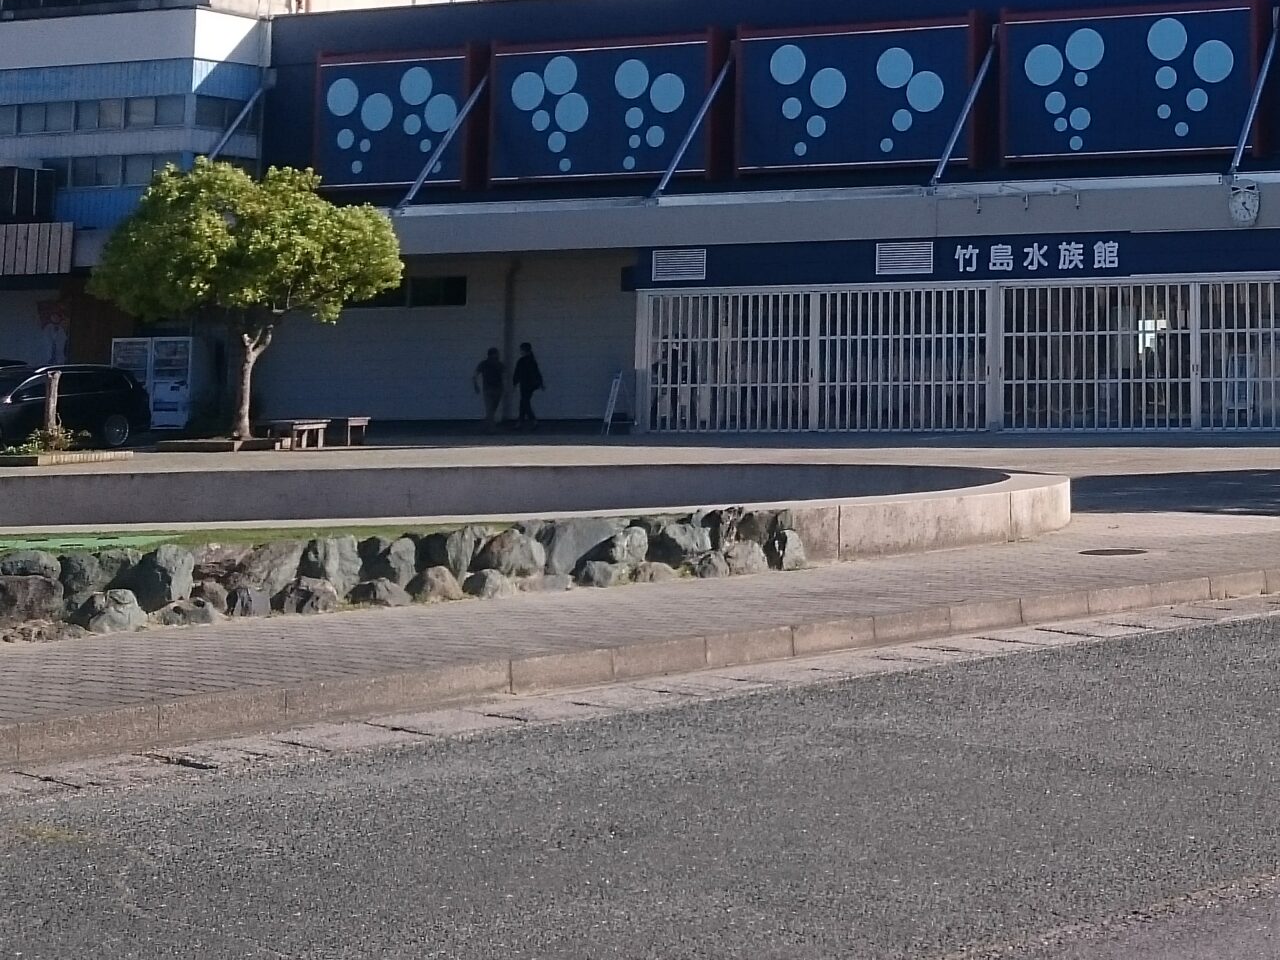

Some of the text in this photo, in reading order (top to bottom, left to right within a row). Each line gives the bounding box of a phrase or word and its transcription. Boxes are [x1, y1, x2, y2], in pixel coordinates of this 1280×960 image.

[954, 240, 1119, 272] 竹島水族館
